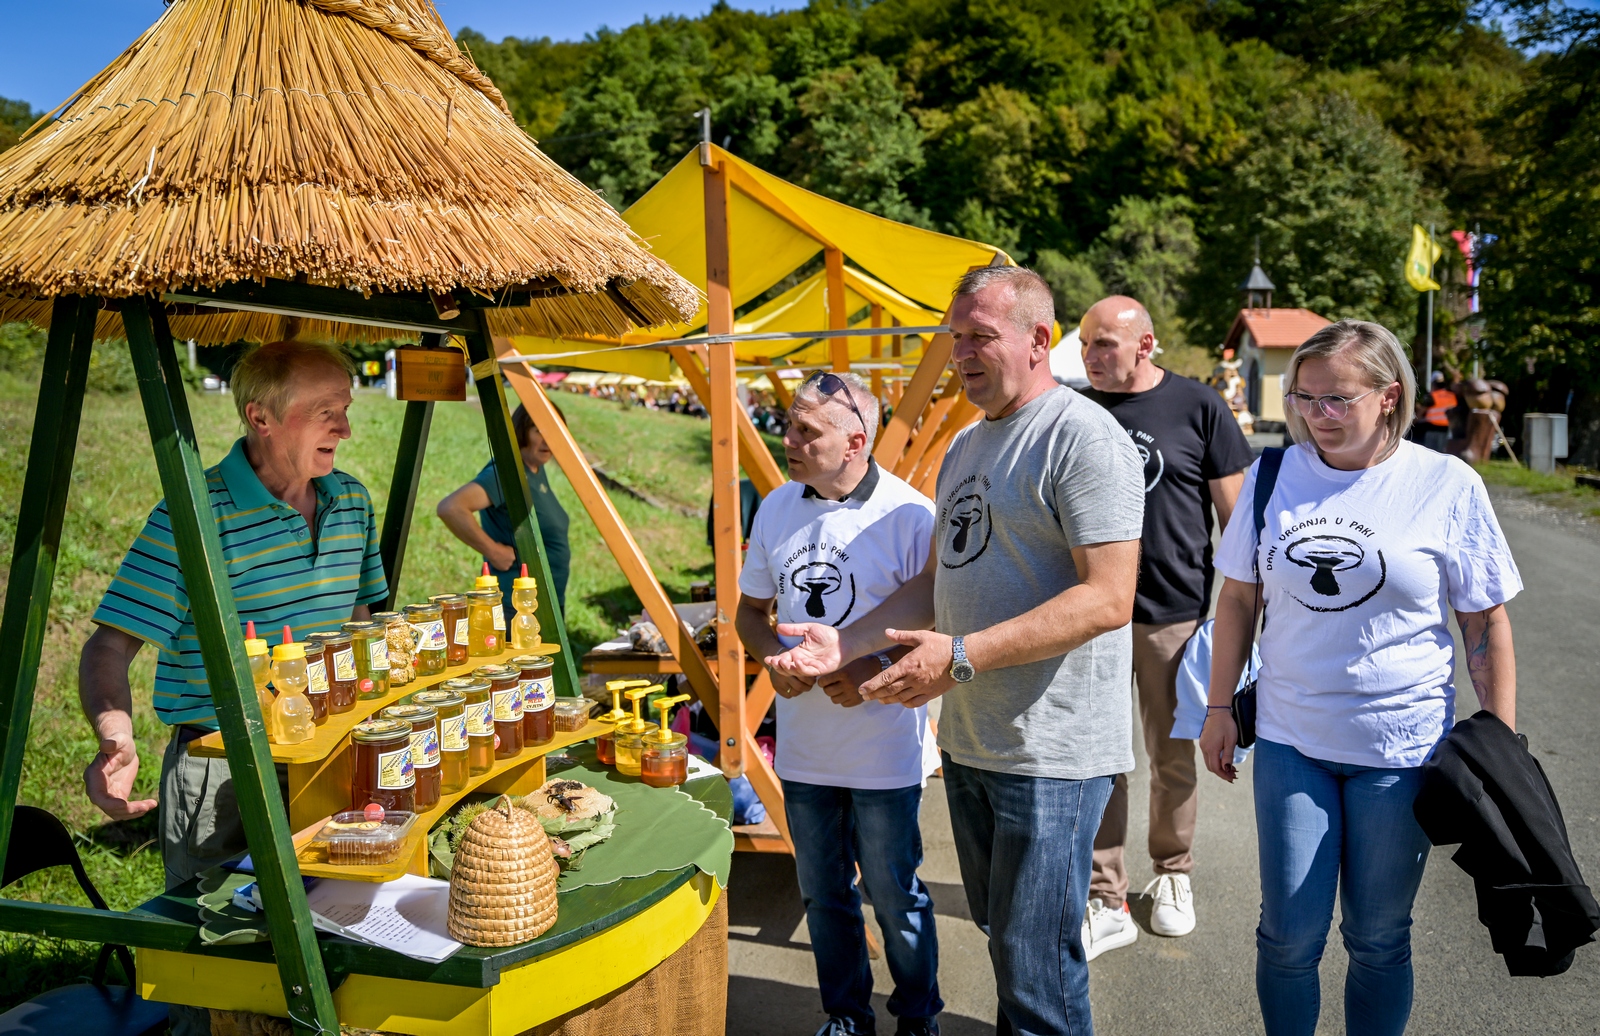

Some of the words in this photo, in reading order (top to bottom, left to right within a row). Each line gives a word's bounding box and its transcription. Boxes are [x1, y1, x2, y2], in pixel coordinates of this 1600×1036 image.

[1136, 430, 1155, 444] PAKI
[778, 572, 786, 595] DANI
[820, 542, 827, 550] U
[830, 545, 850, 563] PAKI
[1266, 545, 1278, 571] DANI
[1335, 517, 1343, 525] U
[1349, 520, 1375, 538] PAKI
